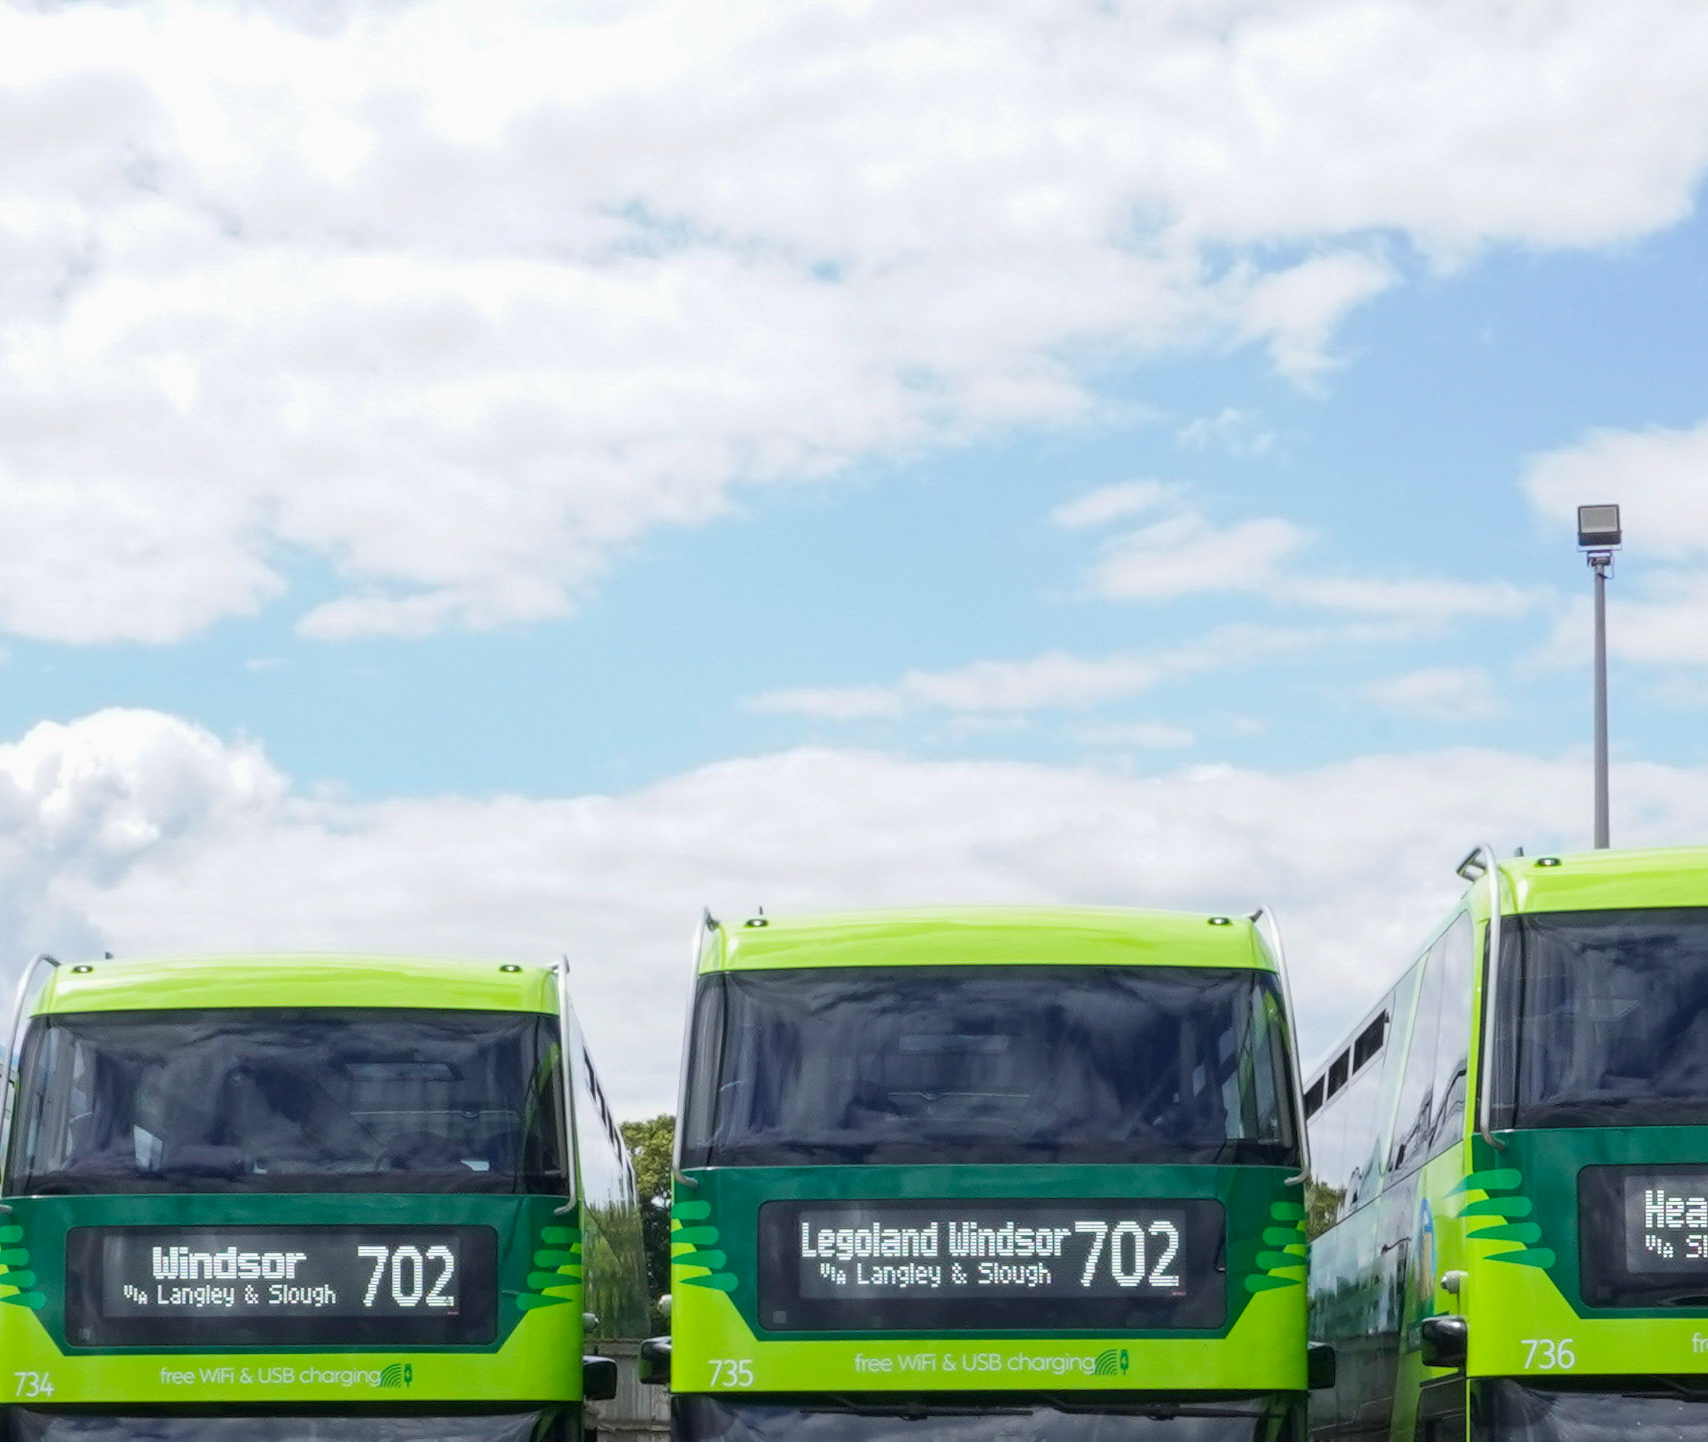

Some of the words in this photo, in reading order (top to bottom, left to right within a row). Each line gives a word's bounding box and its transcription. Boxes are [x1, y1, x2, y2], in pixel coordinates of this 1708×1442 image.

[801, 1222, 938, 1260] Legoland
[948, 1222, 1072, 1257] Windsor
[1074, 1221, 1180, 1288] 702
[152, 1246, 307, 1280] Windsor
[357, 1245, 456, 1308] 702
[857, 1263, 942, 1288] Langley
[951, 1263, 968, 1285] &
[978, 1262, 1051, 1288] Slough
[157, 1284, 235, 1308] Langley
[244, 1284, 259, 1305] &
[268, 1284, 337, 1308] Slough
[854, 1353, 893, 1372] free
[896, 1353, 936, 1372] WiFi
[942, 1353, 958, 1372] &
[961, 1353, 1003, 1372] USB
[1006, 1353, 1097, 1375] charging
[1520, 1338, 1576, 1371] 736
[13, 1372, 55, 1397] 734
[159, 1367, 195, 1385] free
[198, 1367, 235, 1385] WiFi
[240, 1367, 255, 1385] &
[257, 1367, 295, 1385] USB
[298, 1367, 382, 1388] charging
[707, 1358, 754, 1388] 735
